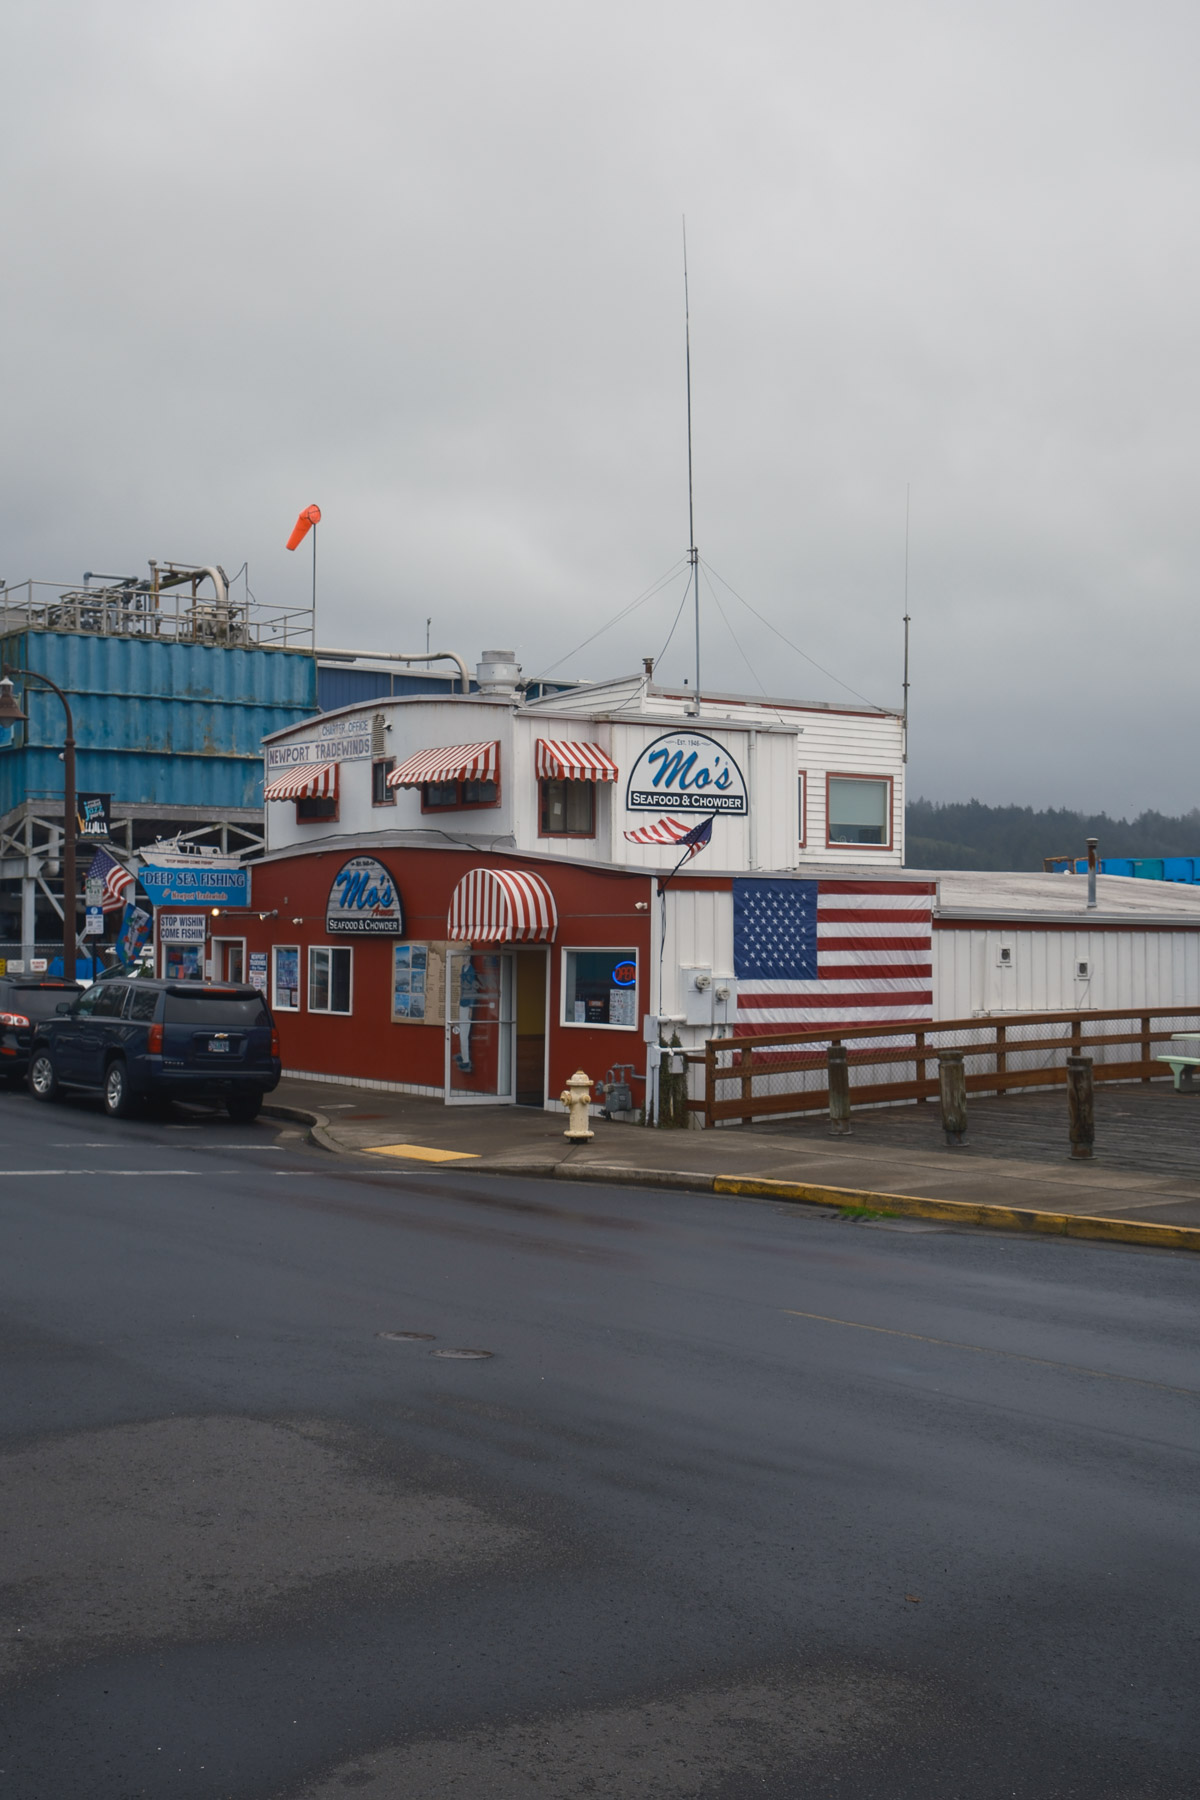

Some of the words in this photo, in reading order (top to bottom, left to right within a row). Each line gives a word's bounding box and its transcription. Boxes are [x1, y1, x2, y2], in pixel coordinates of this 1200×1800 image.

[321, 723, 346, 737] CHARTER
[348, 720, 368, 733] OFFICE
[269, 746, 310, 765] NEWPORT
[315, 738, 370, 760] TRADEWINDS
[648, 747, 733, 791] Mo's
[632, 793, 680, 805] SEAFOOD
[681, 795, 690, 806] &
[691, 795, 742, 808] CHOWDER
[144, 871, 174, 885] DEEP
[176, 873, 198, 886] SEA
[200, 873, 245, 887] FISHING
[336, 869, 394, 910] Mo's
[160, 916, 178, 926] STOP
[329, 919, 358, 930] SEAFOOD
[359, 920, 365, 930] &
[364, 919, 398, 930] CHOWDER
[160, 928, 180, 938] COME
[614, 966, 636, 981] OPEN
